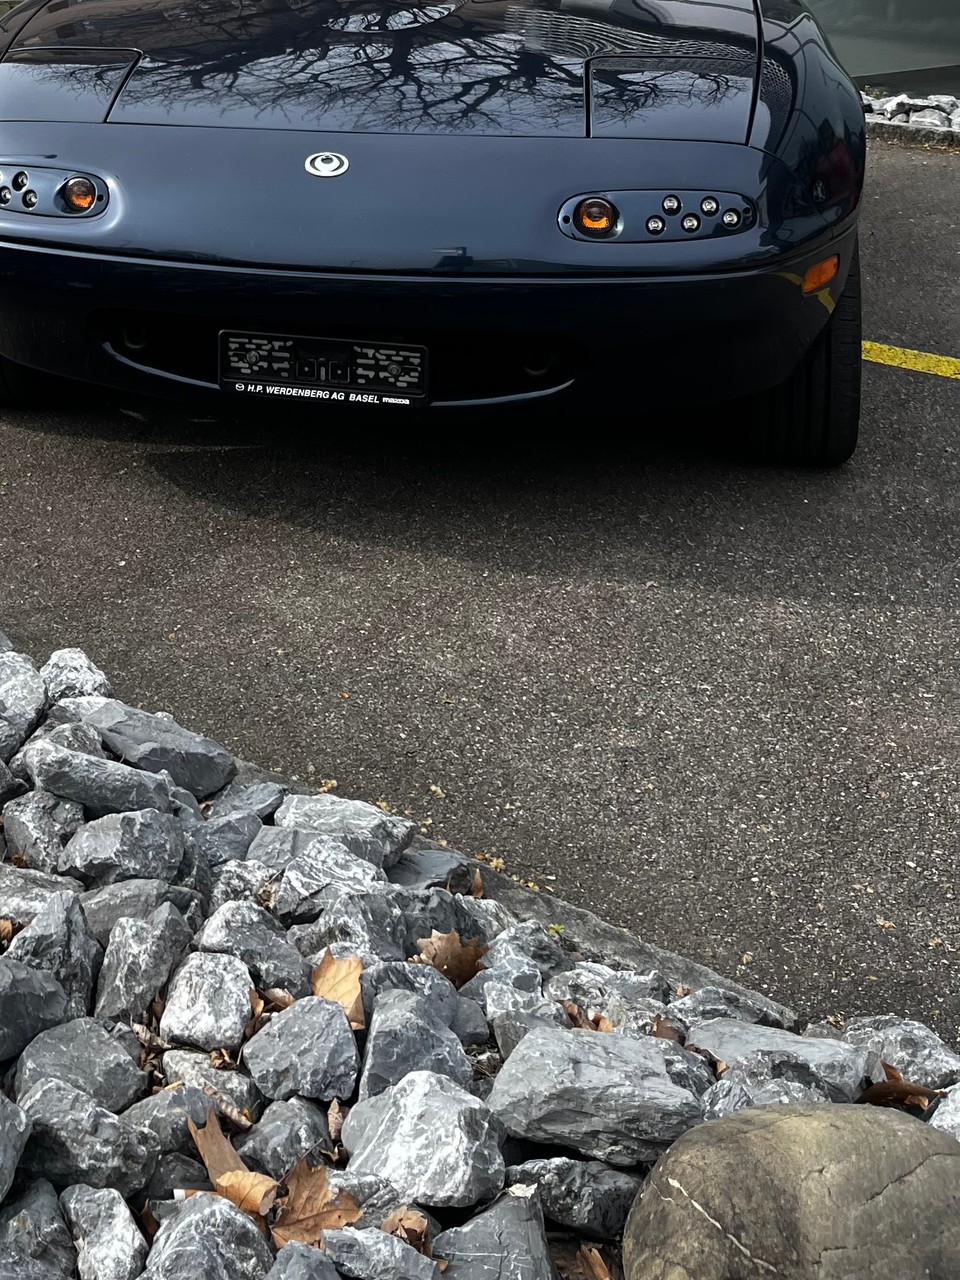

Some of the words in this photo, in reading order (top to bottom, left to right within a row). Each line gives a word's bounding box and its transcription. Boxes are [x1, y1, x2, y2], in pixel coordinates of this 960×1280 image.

[247, 384, 264, 394] H.P.
[265, 385, 330, 399] WERDENBERG
[330, 391, 345, 400] AG
[348, 393, 380, 404] BASEL
